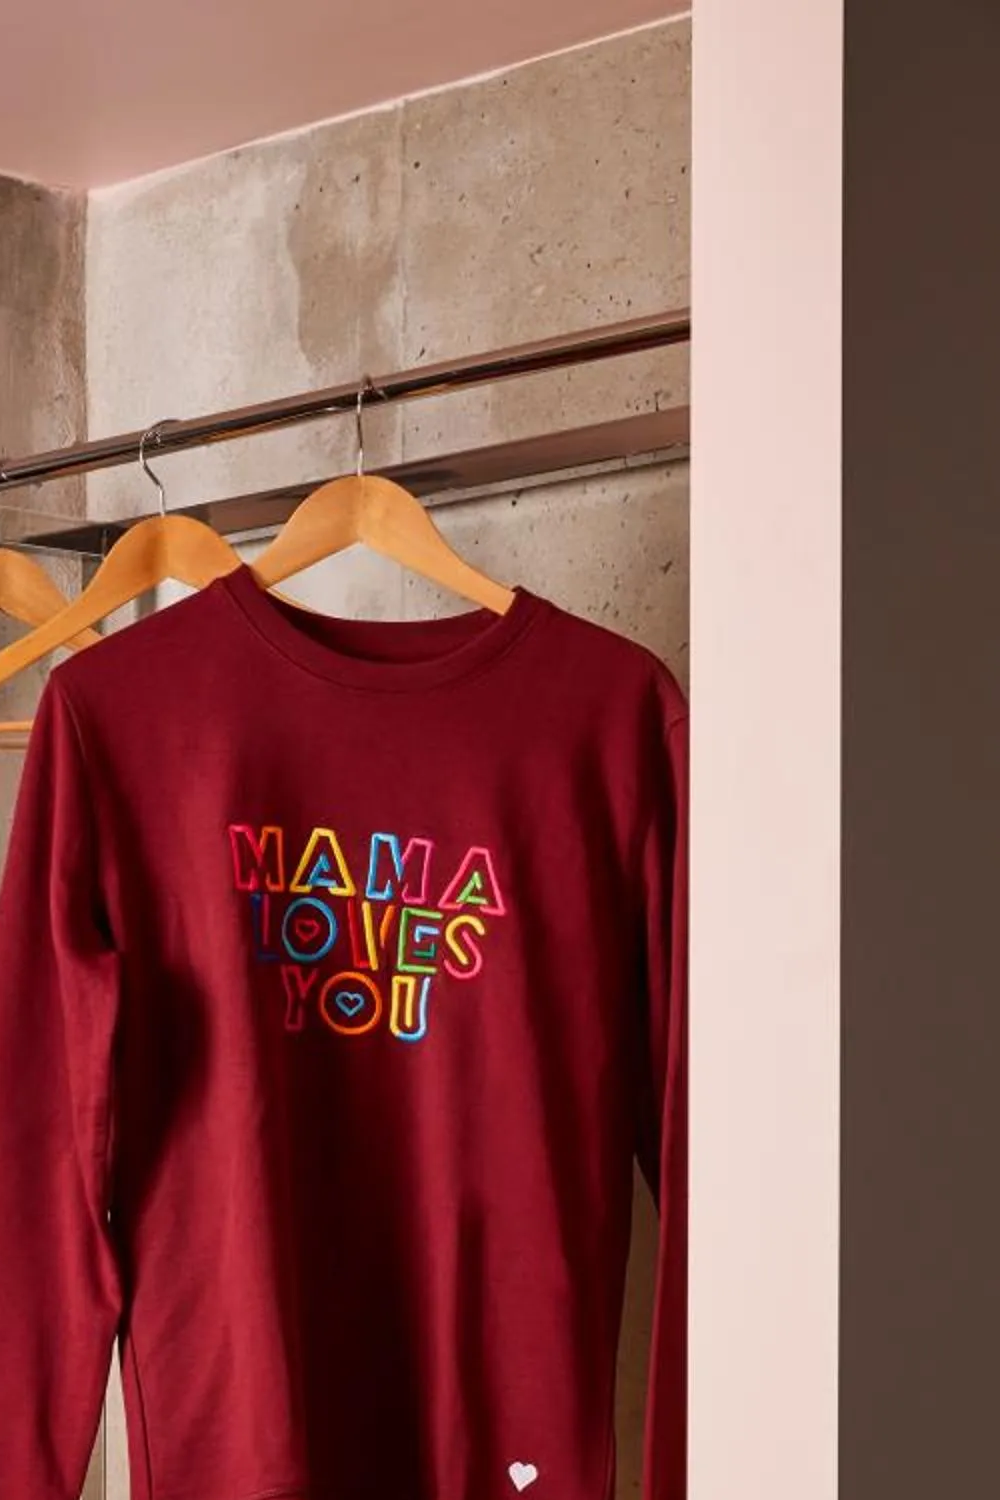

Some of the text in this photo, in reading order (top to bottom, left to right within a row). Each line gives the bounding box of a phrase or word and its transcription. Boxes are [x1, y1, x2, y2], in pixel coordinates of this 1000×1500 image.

[229, 824, 506, 915] MAMA
[253, 892, 486, 979] LOVES
[282, 965, 431, 1042] YOU
